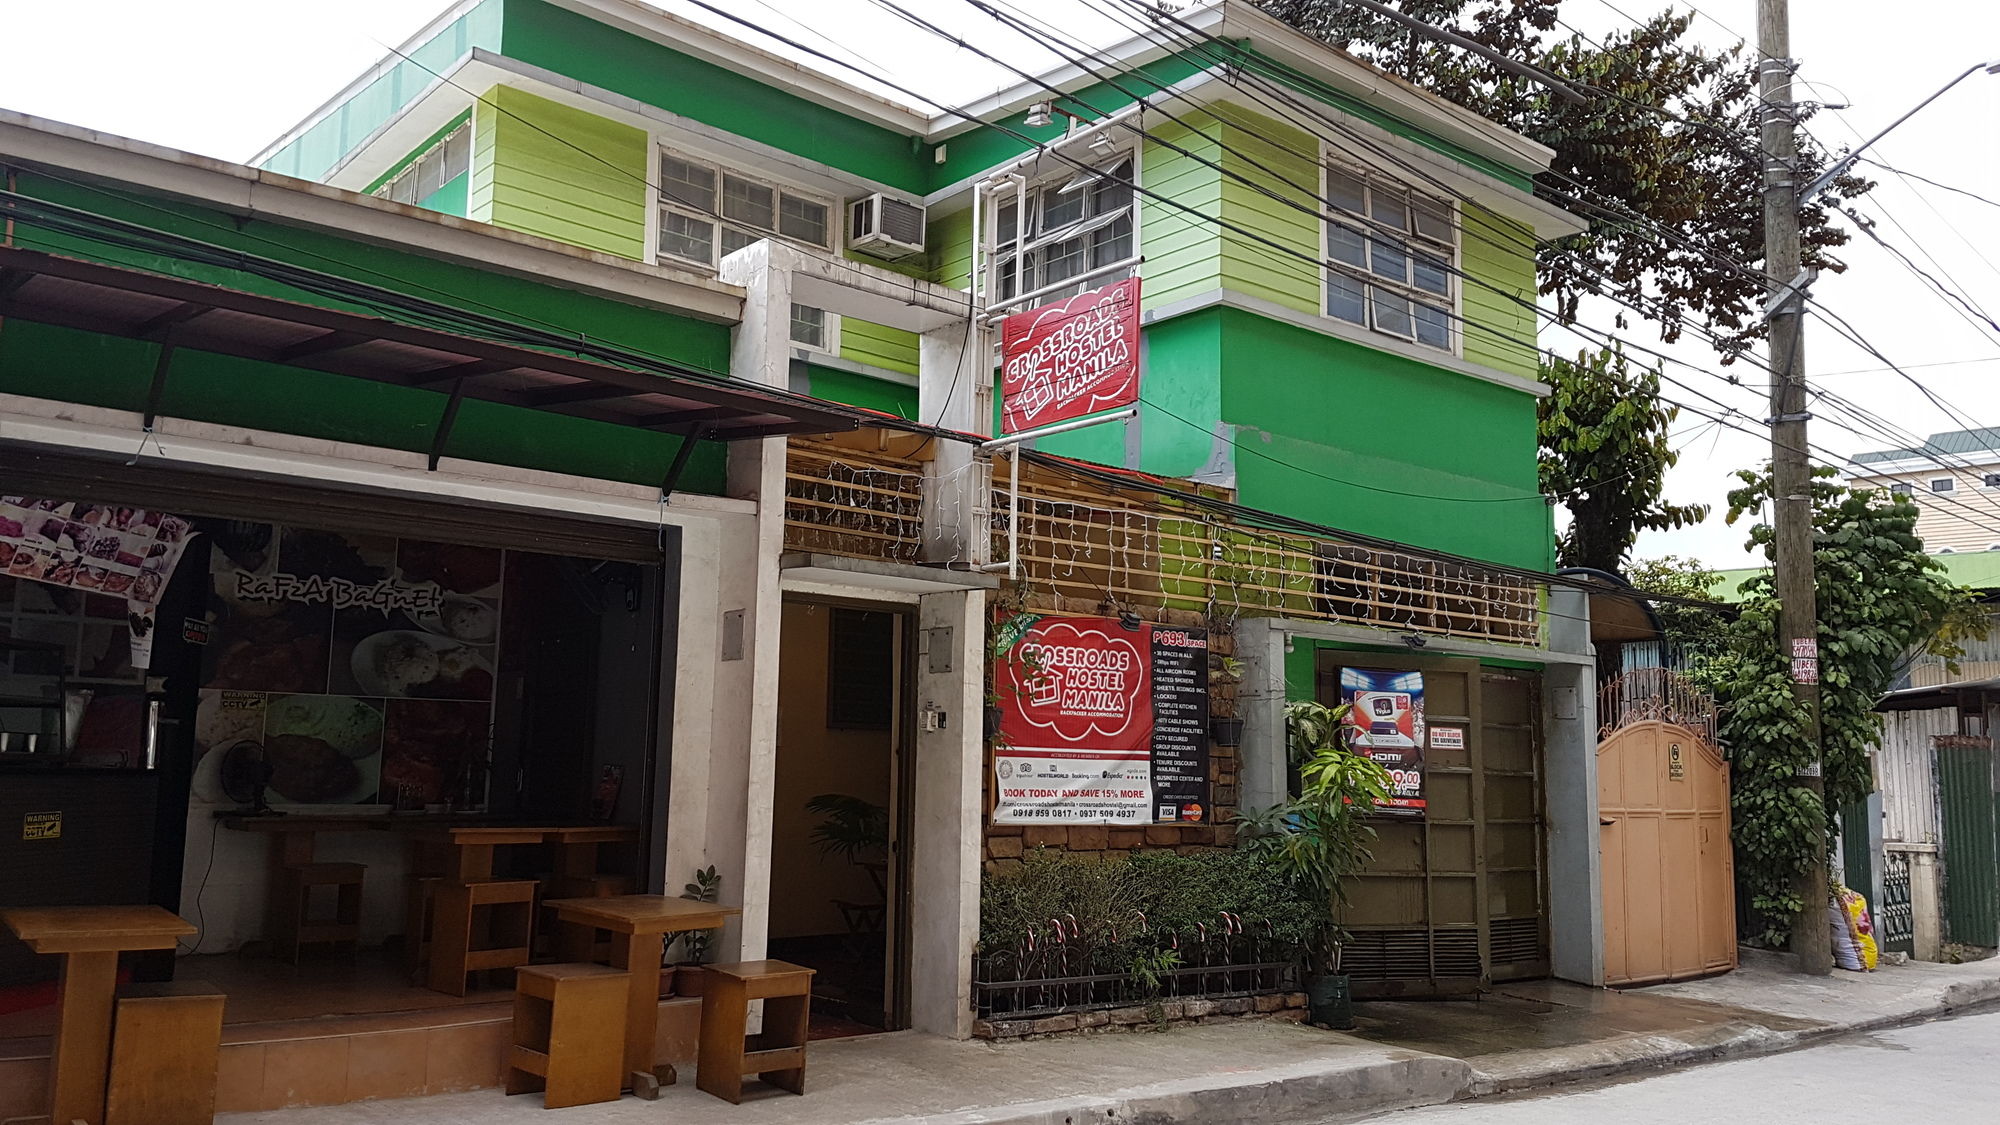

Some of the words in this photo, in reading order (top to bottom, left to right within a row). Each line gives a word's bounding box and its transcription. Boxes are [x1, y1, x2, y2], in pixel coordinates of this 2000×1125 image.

[1007, 287, 1126, 383] CROSSROADS
[1055, 315, 1124, 376] HOSTEL
[1056, 339, 1128, 401] MANILA
[1065, 668, 1125, 690] HOSTEL
[223, 691, 265, 699] WARNING
[1061, 689, 1125, 711] MANILA
[223, 700, 248, 708] CCTV
[1370, 753, 1402, 761] HDMI
[1003, 788, 1026, 798] BOOK
[1028, 788, 1058, 798] TODAY
[1061, 789, 1079, 798] AND
[1080, 789, 1100, 798] SAVE
[1101, 790, 1119, 799] 15%
[1120, 790, 1145, 799] MORE
[1013, 809, 1034, 817] 0918
[1035, 809, 1050, 817] 959
[1052, 809, 1072, 818] 0817
[1079, 810, 1097, 818] 0937
[1099, 810, 1114, 818] 509
[1116, 810, 1136, 818] 4937
[1161, 808, 1174, 816] VISA
[26, 813, 60, 823] WARNING
